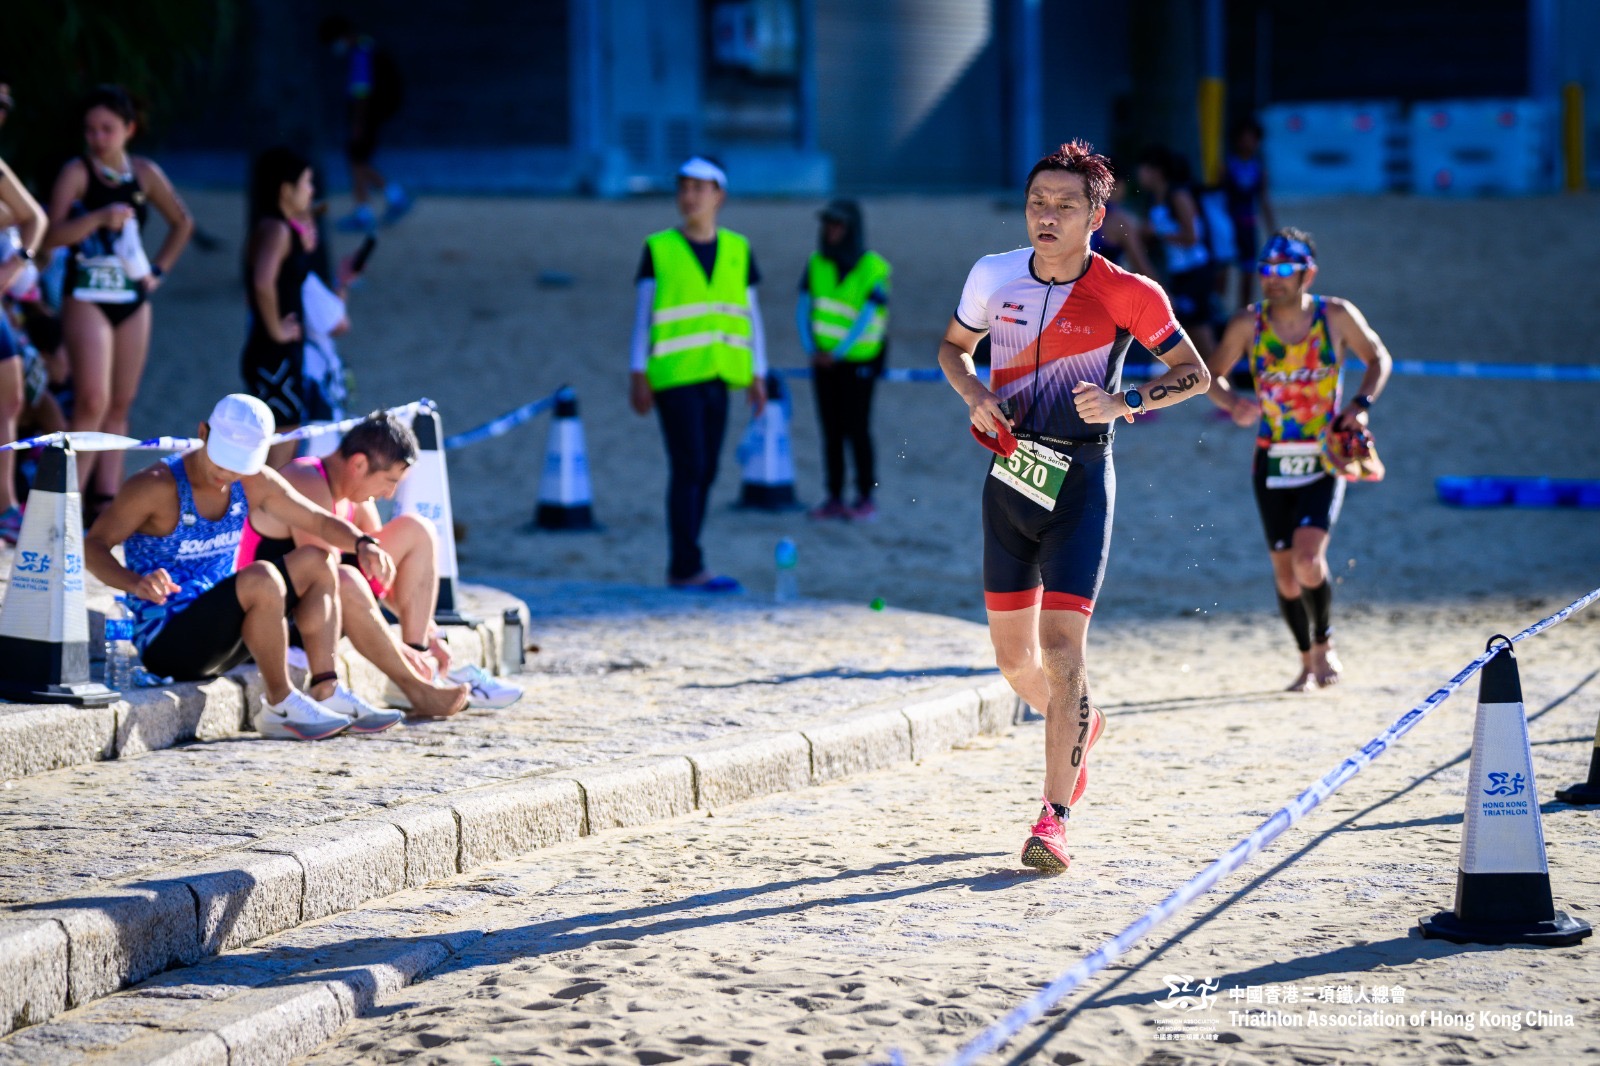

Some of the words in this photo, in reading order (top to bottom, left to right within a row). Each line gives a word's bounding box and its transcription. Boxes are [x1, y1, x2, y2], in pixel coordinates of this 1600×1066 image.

[1149, 372, 1200, 401] 570
[1019, 441, 1047, 460] Aqulon
[1047, 456, 1068, 468] Series
[1279, 456, 1317, 475] 627
[1008, 450, 1048, 488] 570
[12, 582, 48, 591] TRIATHLON
[1070, 695, 1090, 768] 570
